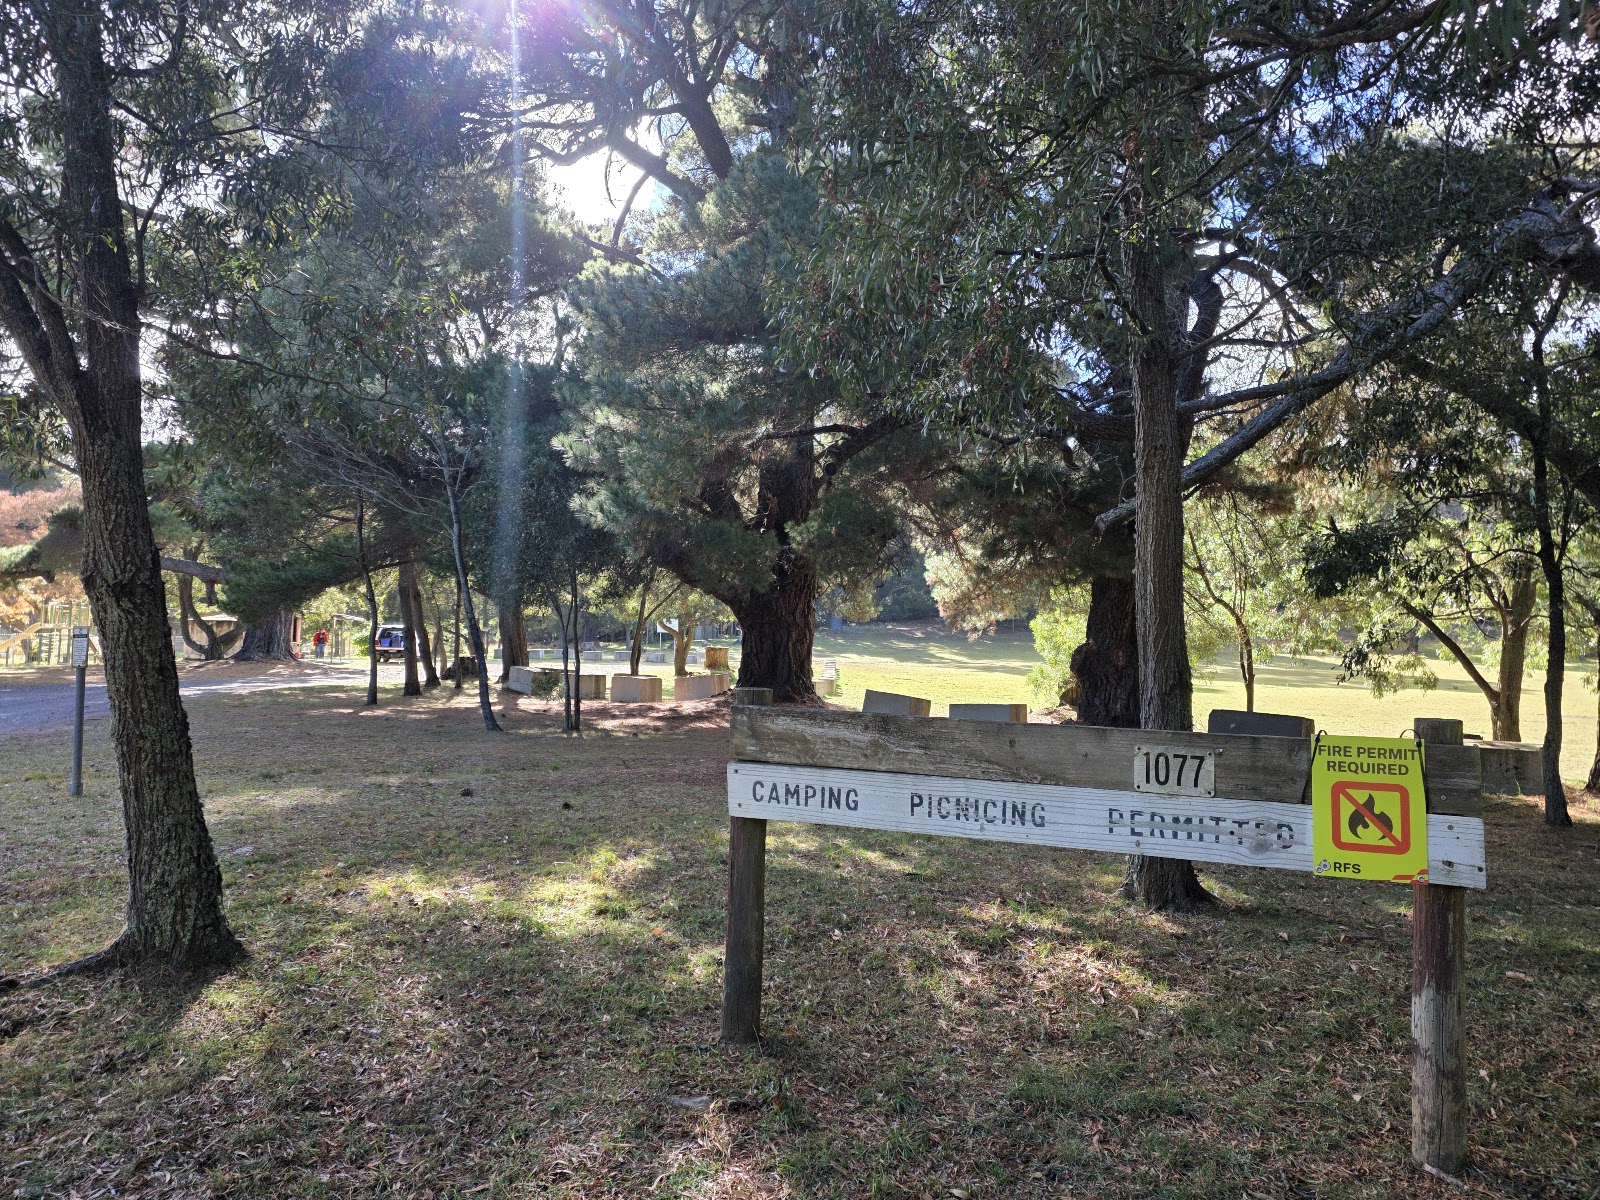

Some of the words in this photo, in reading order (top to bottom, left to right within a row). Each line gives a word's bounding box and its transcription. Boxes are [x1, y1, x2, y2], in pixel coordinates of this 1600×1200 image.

[1317, 744, 1353, 758] FIRE
[1356, 746, 1419, 761] PERMIT
[1143, 751, 1205, 788] 1077
[1326, 760, 1410, 776] REQUIRED
[752, 780, 859, 812] CAMPING
[910, 792, 1046, 828] PICNICING
[1333, 861, 1362, 874] RFS
